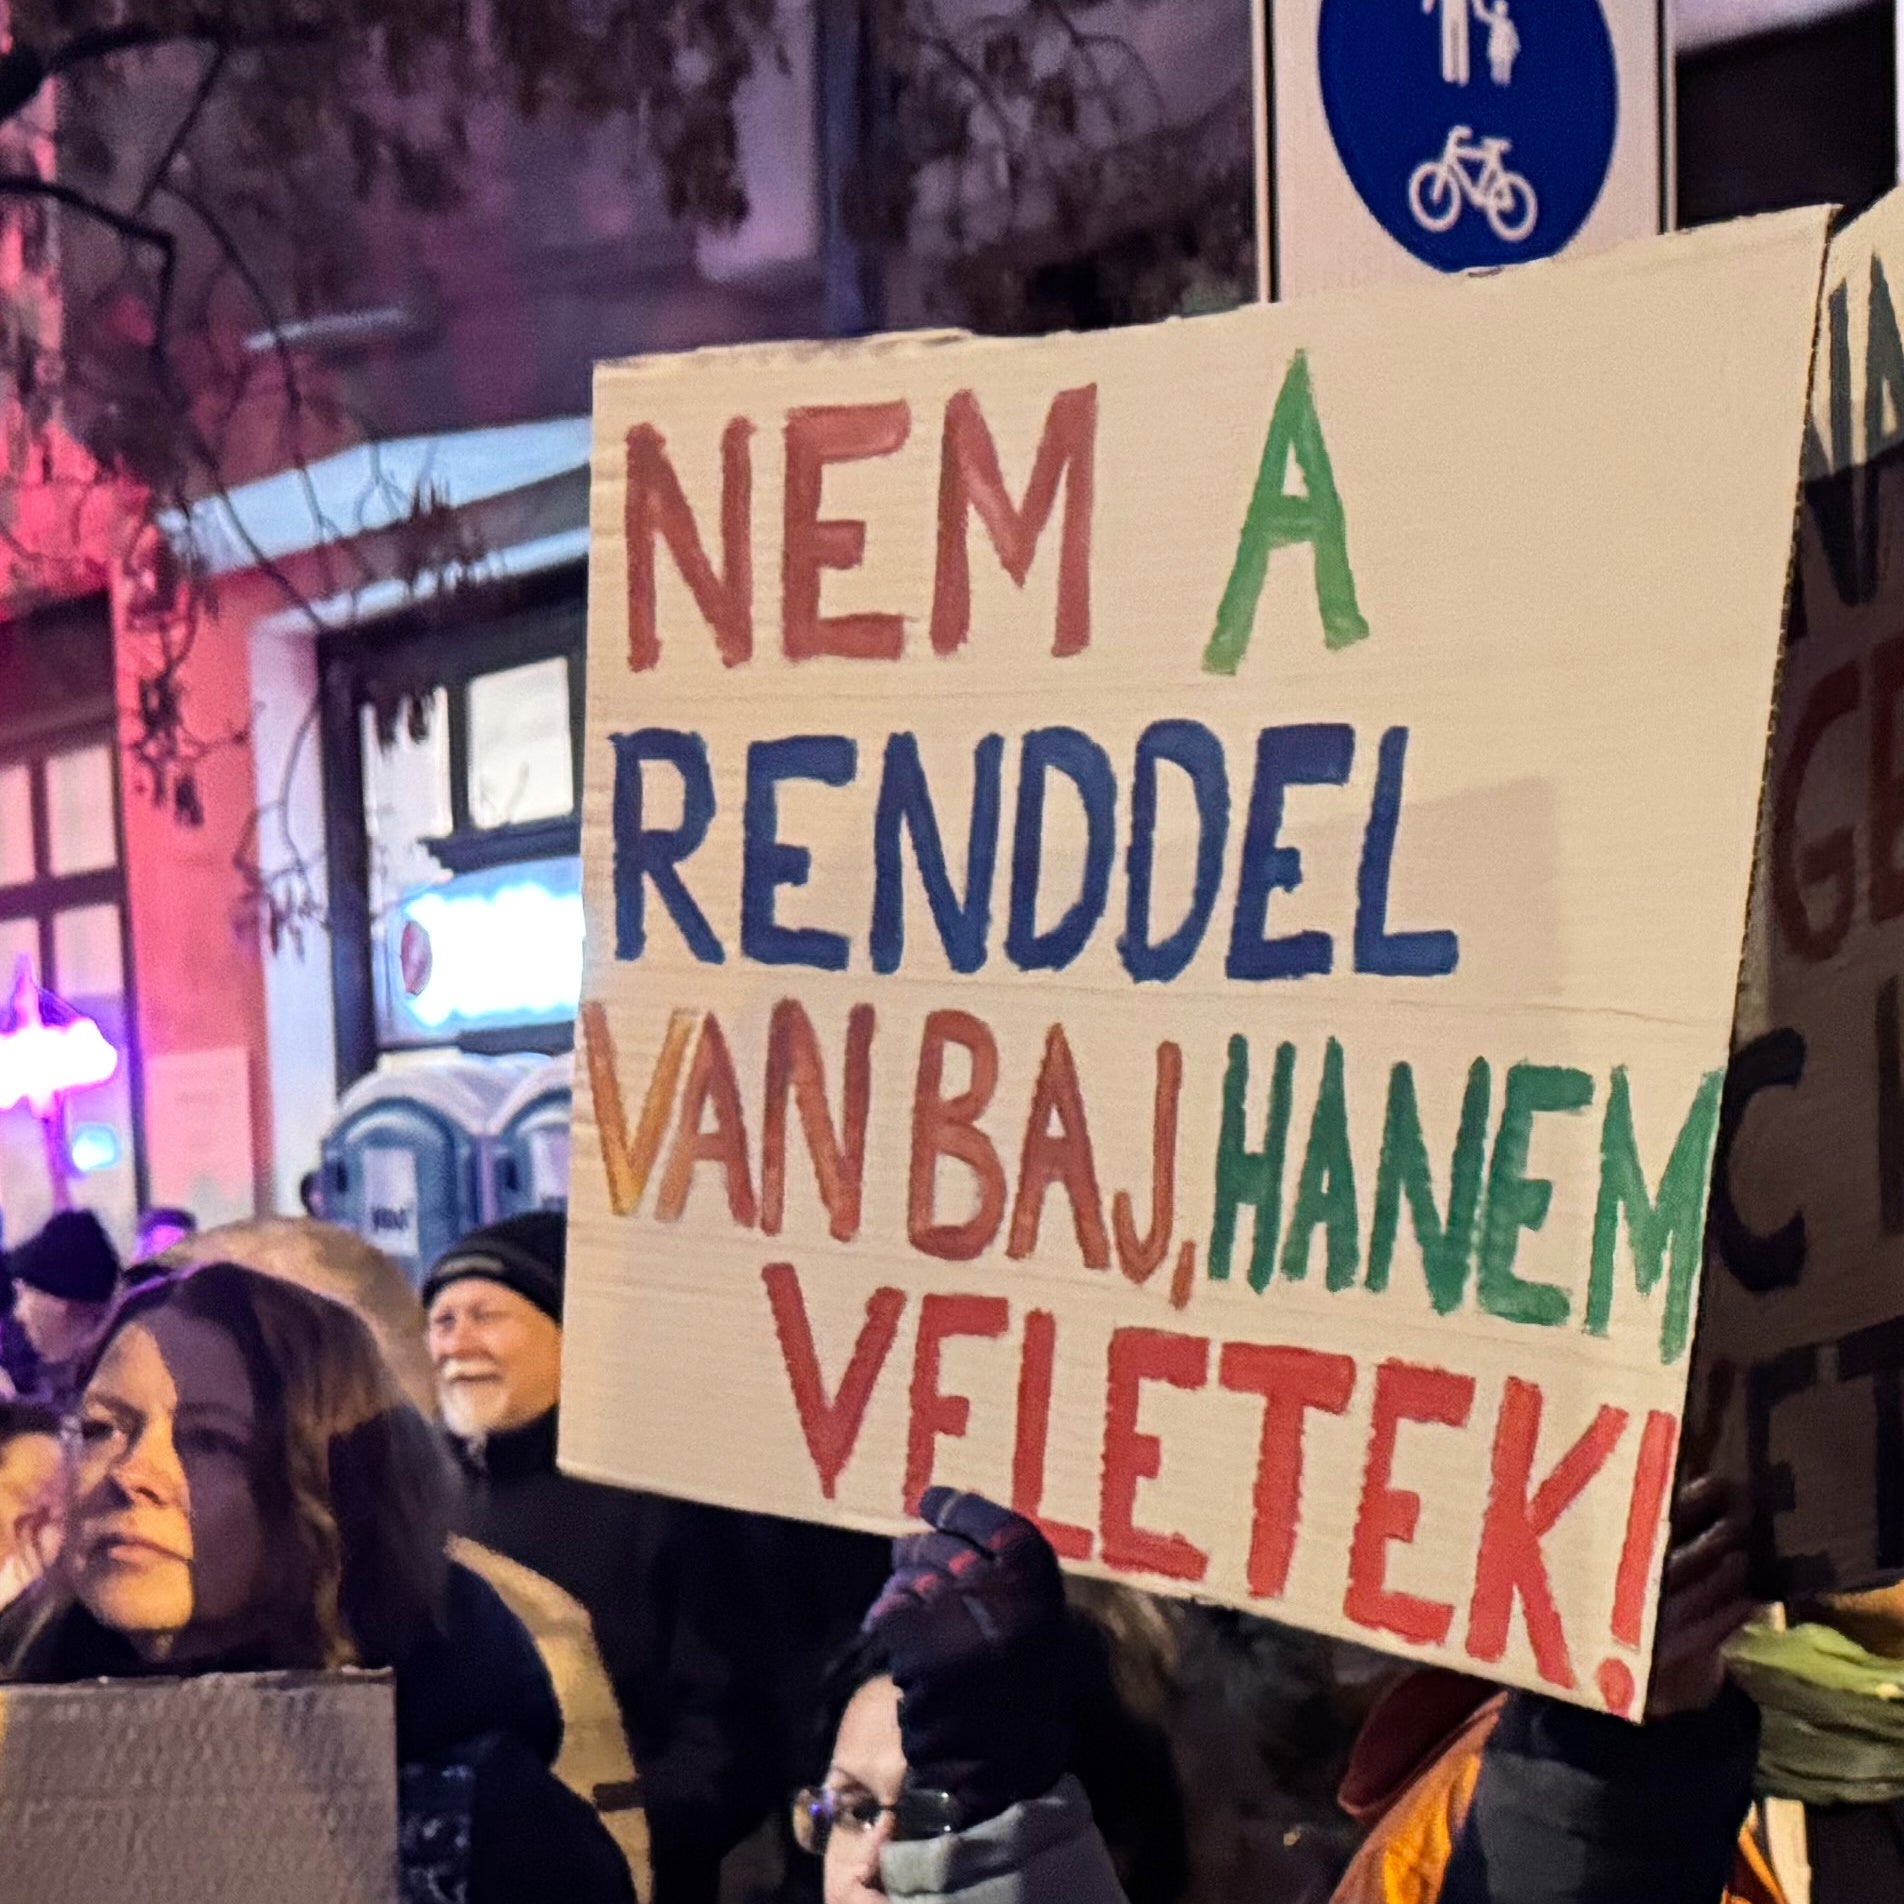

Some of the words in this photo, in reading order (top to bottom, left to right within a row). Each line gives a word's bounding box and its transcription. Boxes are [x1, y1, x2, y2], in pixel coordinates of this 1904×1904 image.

[624, 383, 1098, 672] NEM
[1202, 349, 1369, 675] A
[607, 718, 1460, 982] RENDDEL
[581, 999, 875, 1241] VAN
[762, 1262, 1678, 1714] VELETEK!
